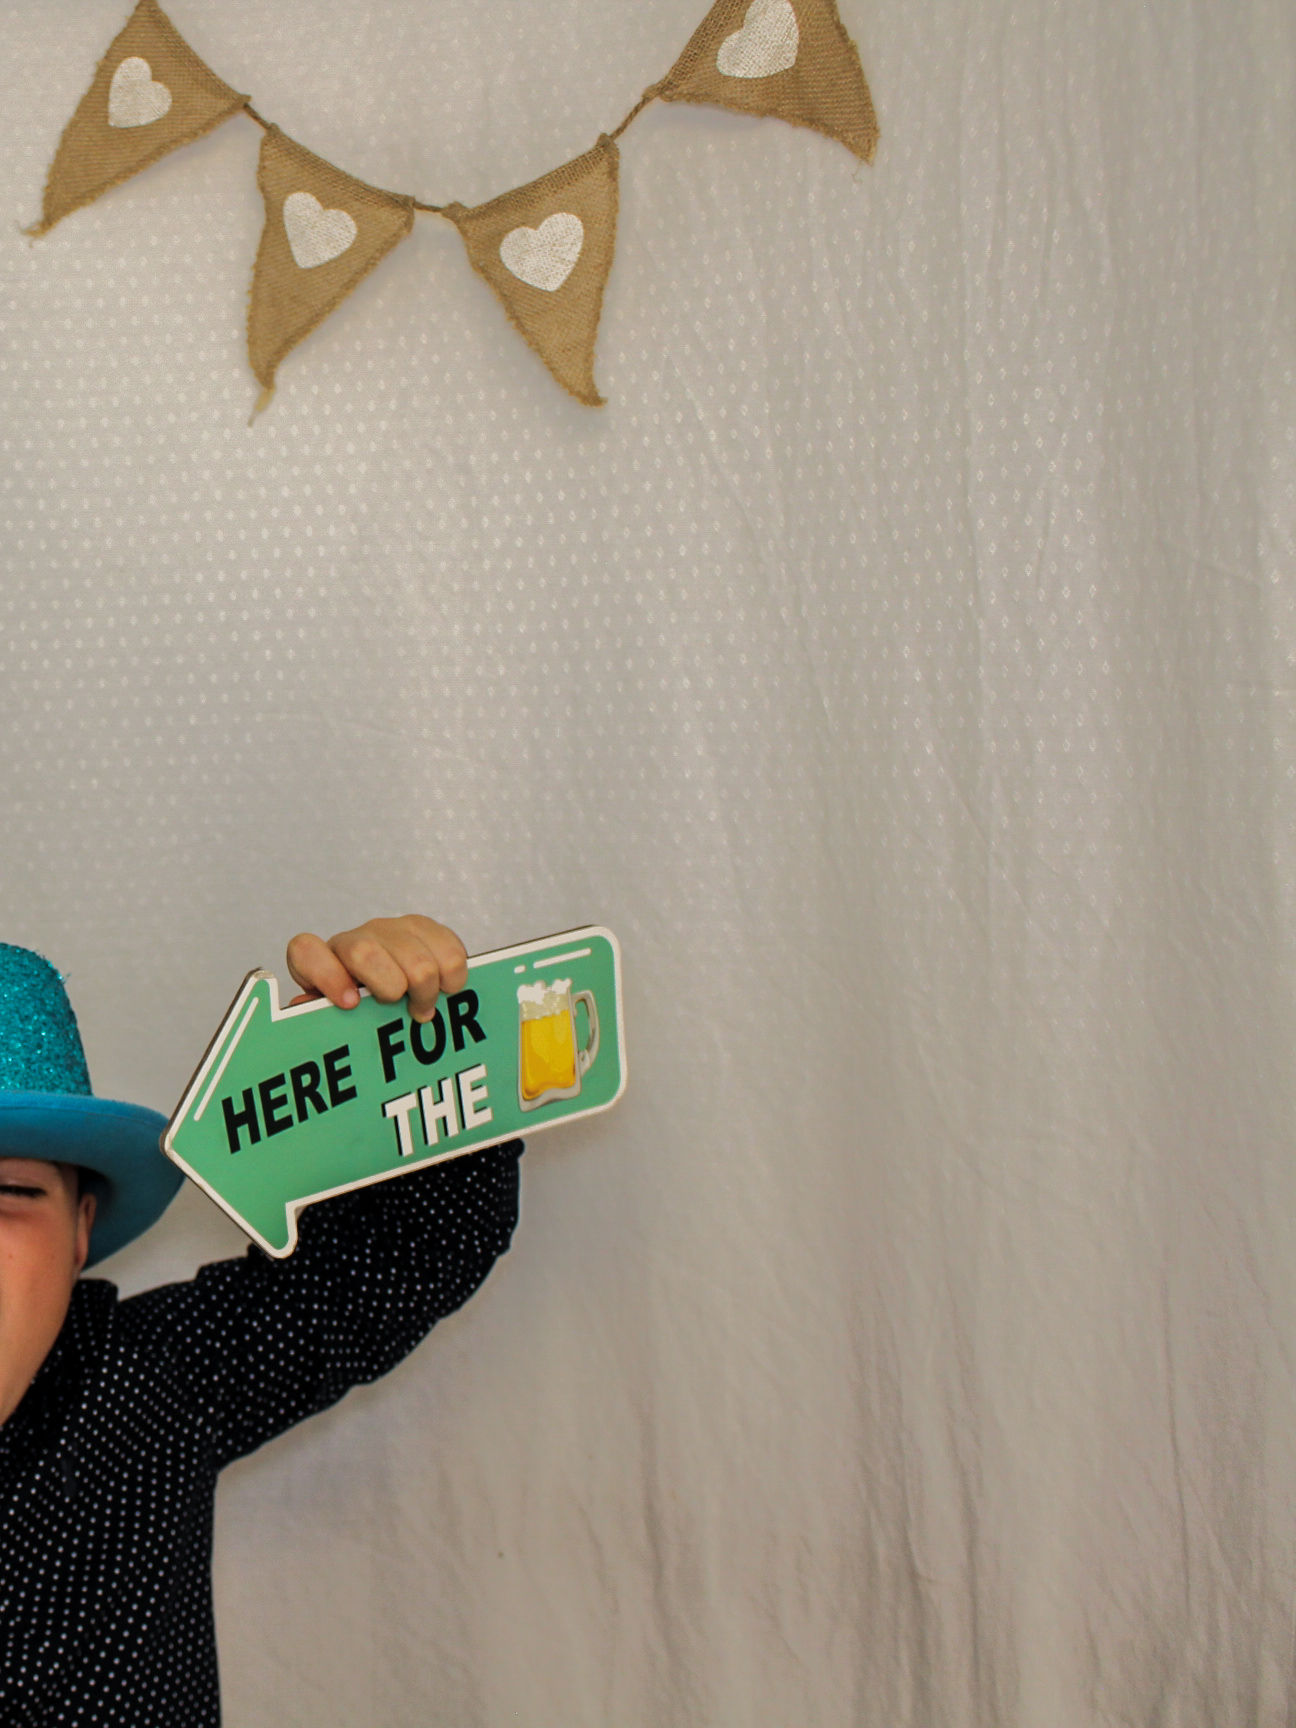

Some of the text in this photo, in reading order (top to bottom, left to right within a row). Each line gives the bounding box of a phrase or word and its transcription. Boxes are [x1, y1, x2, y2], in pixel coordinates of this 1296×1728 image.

[222, 989, 487, 1154] HERE FOR
[382, 1064, 493, 1157] THE
